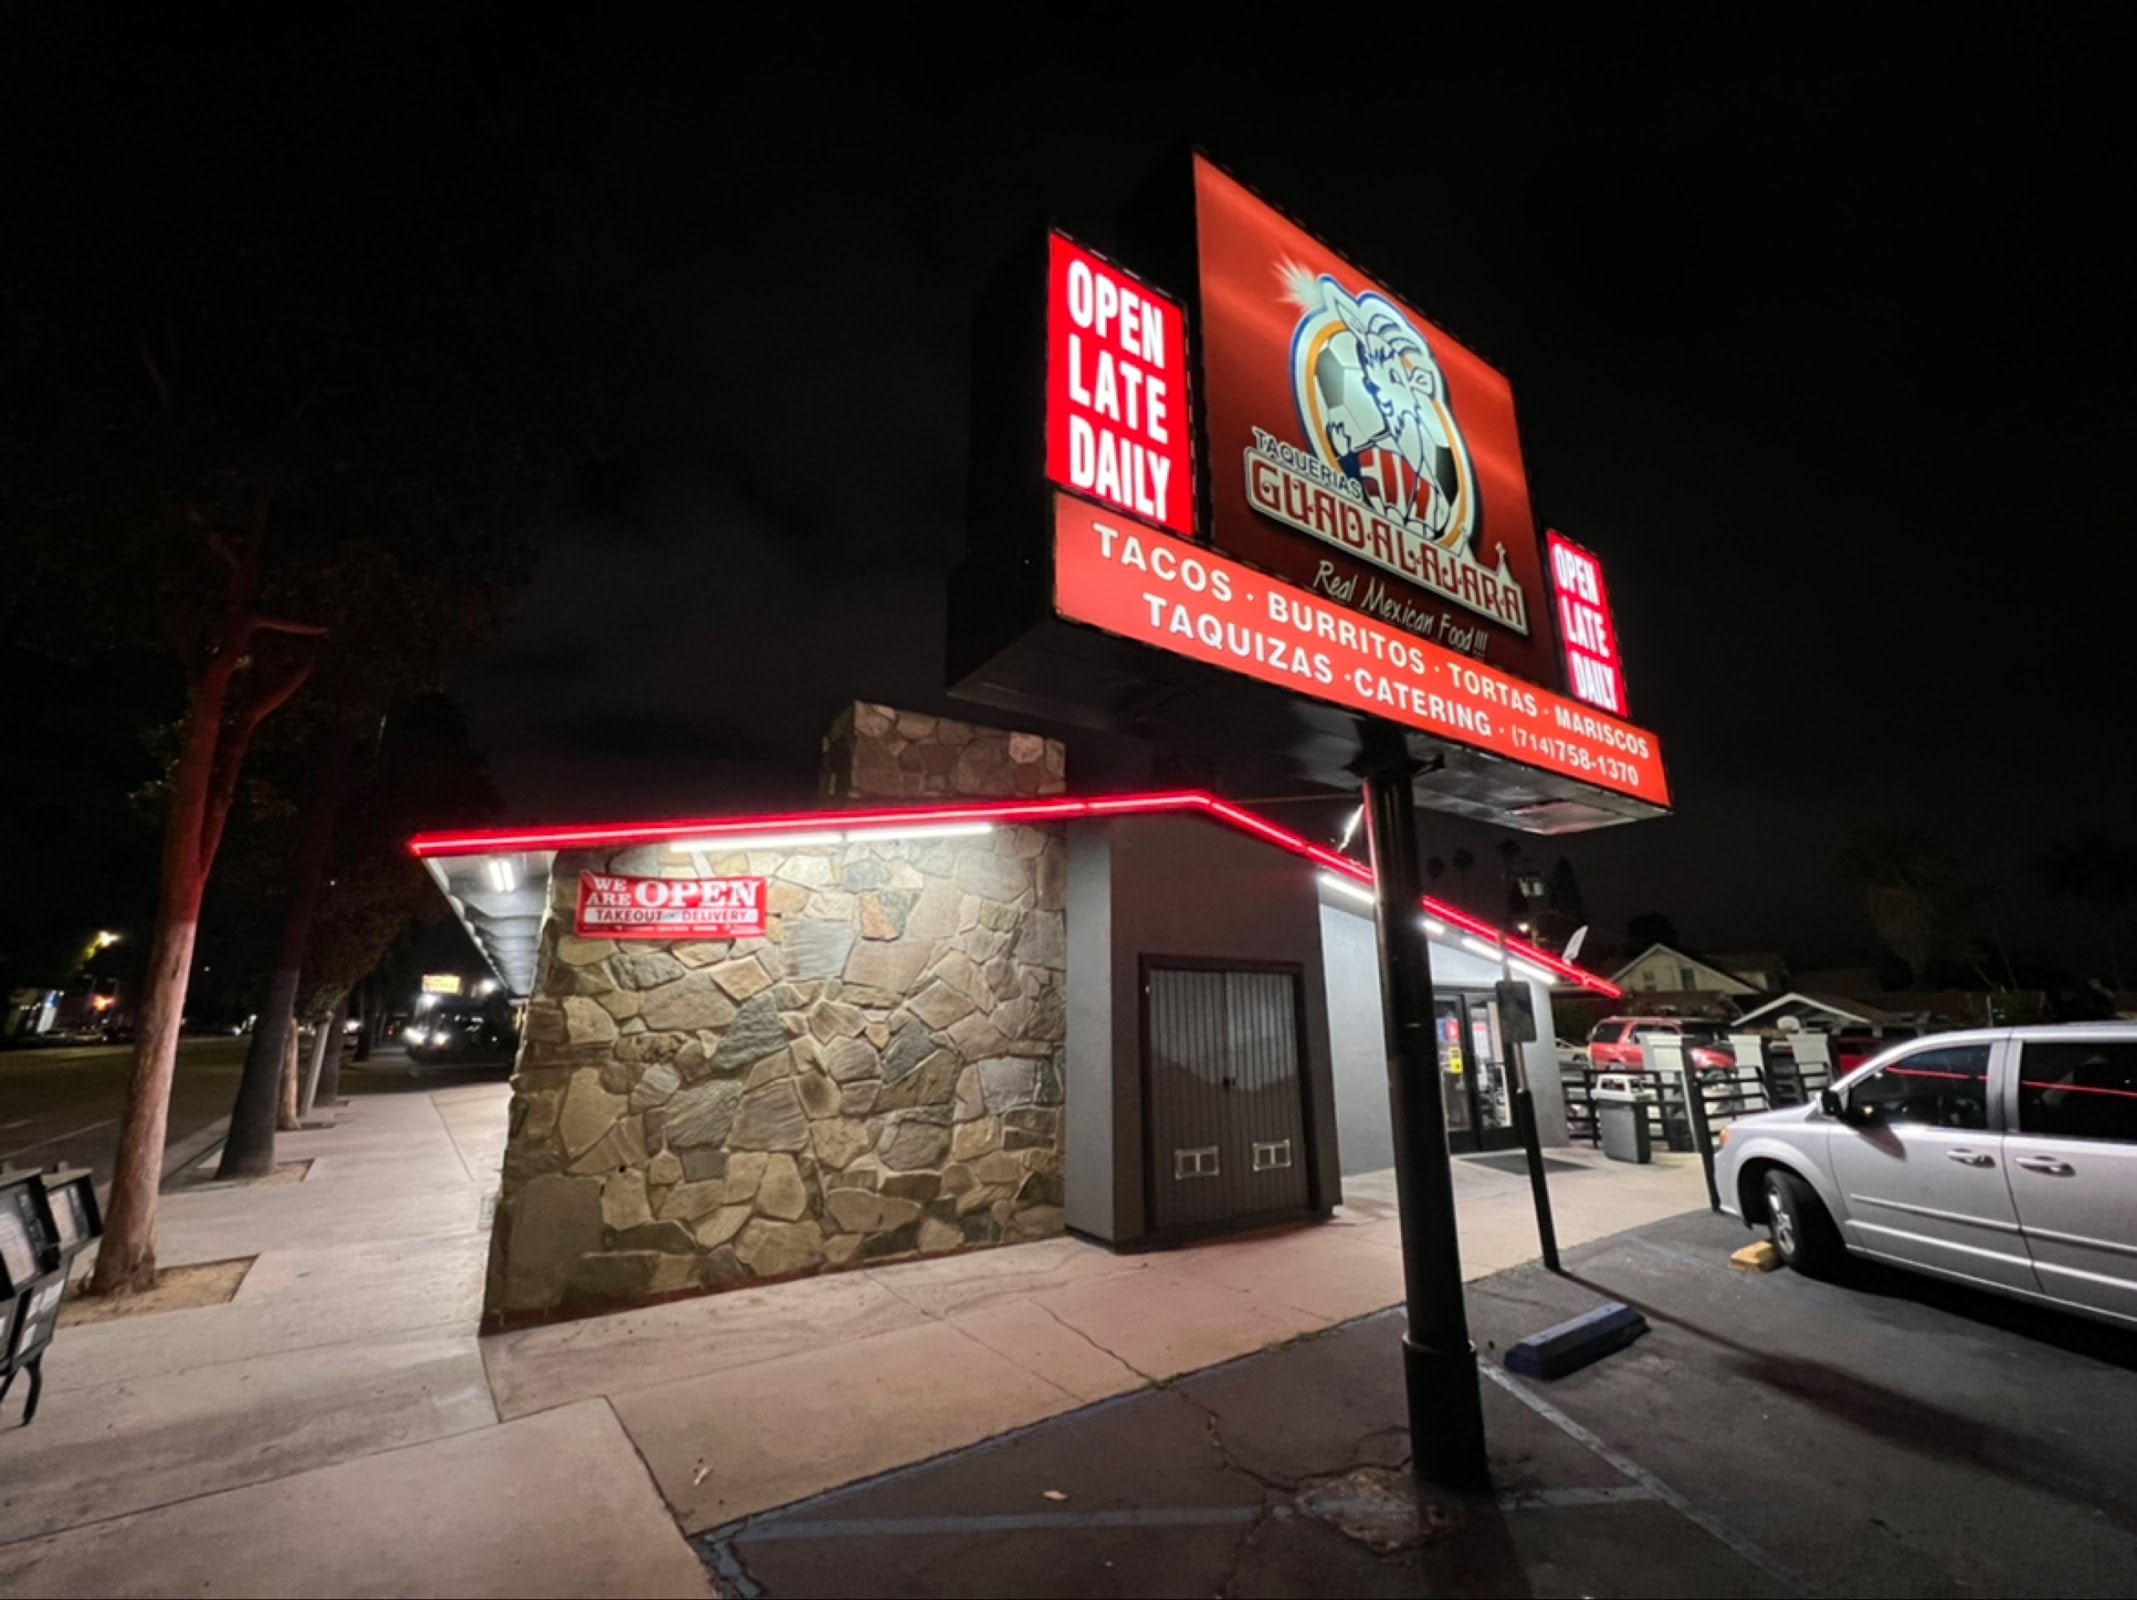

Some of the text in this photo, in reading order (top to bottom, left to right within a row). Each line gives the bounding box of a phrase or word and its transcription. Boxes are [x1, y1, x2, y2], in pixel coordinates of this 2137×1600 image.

[1067, 259, 1165, 369] OPEN
[1068, 333, 1169, 444] LATE
[1069, 413, 1171, 522] DAILY
[1254, 430, 1362, 499] TAQUERIAS
[1252, 459, 1524, 628] GUADALAJARA
[1553, 543, 1600, 606] OPEN
[1312, 559, 1359, 600] Real
[1360, 575, 1435, 636] Mexican
[1561, 594, 1610, 658] LATE
[1093, 522, 1650, 759] TACOS BURRITOS TORTAS MARISCOS
[1142, 592, 1640, 787] TAQUIZAS CATERING (714)758-1370
[586, 893, 631, 906] ARE
[593, 878, 627, 891] WE
[597, 909, 748, 922] TAKEOUT DELIVERY
[634, 880, 761, 908] OPEN
